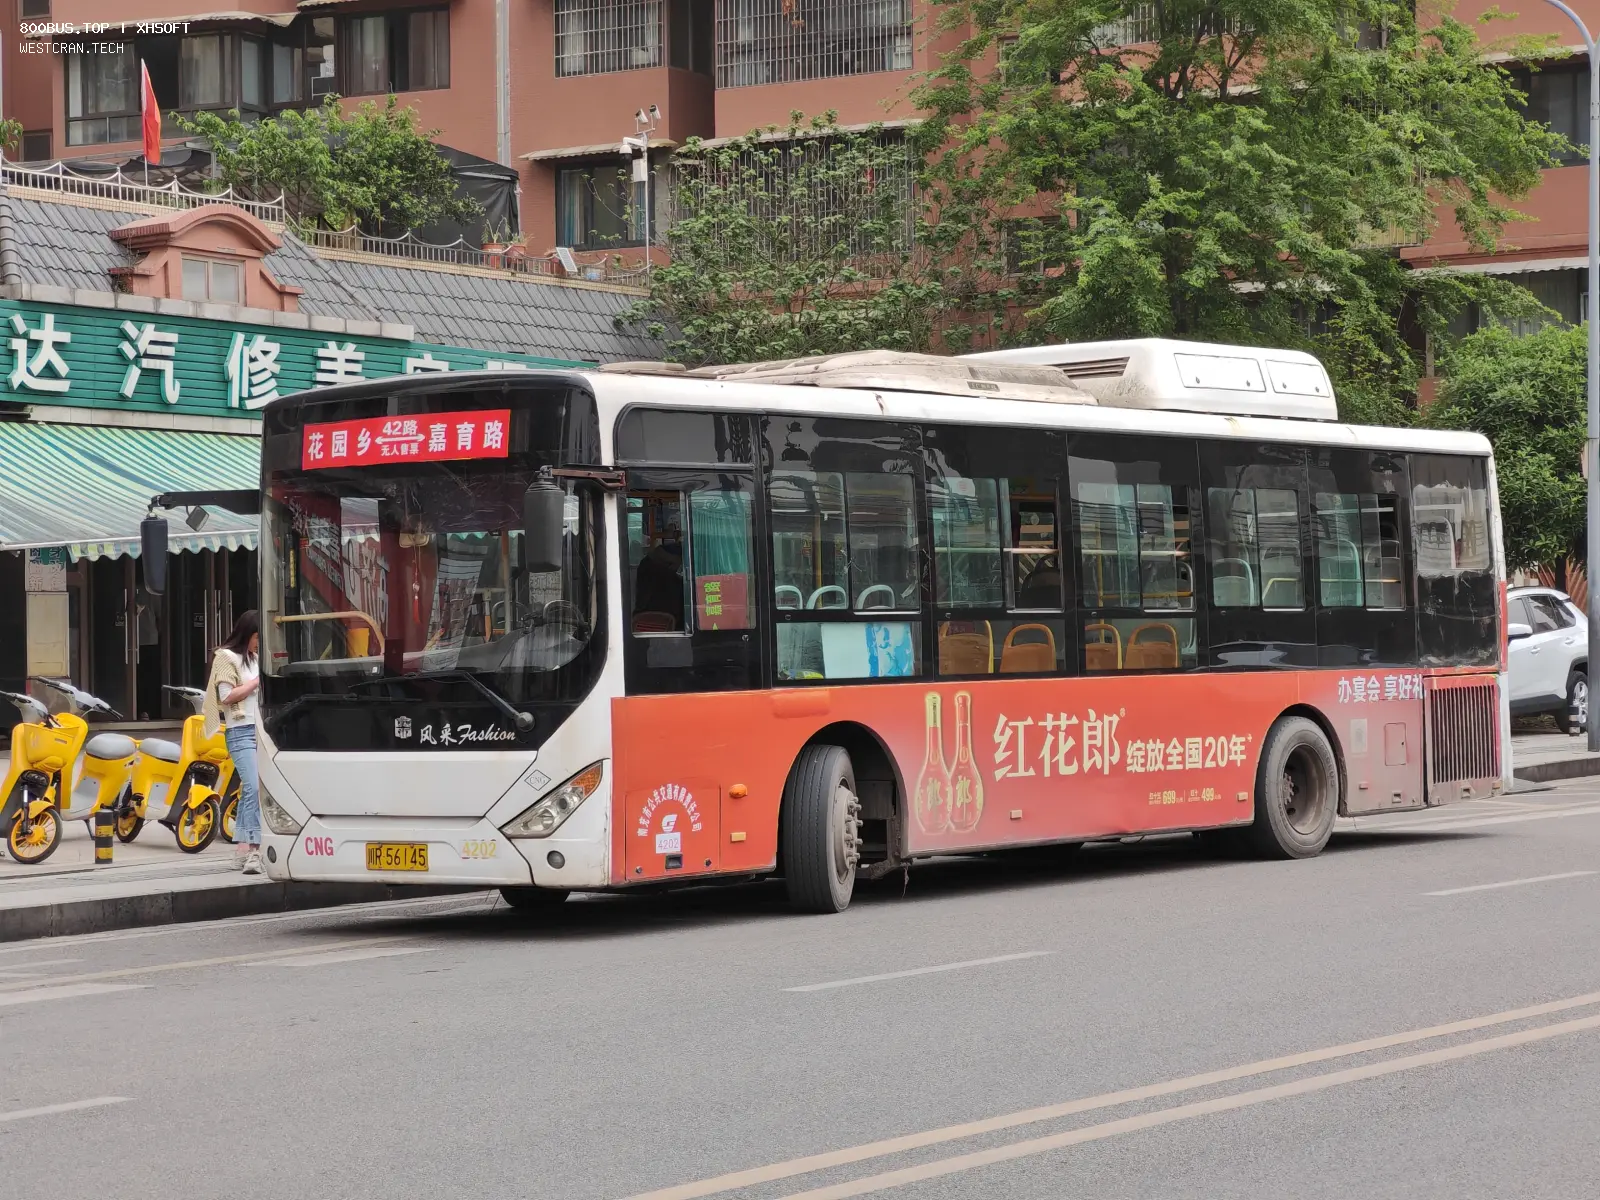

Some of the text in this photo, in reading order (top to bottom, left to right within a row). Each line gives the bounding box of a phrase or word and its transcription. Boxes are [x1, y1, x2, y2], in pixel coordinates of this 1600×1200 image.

[7, 313, 527, 411] 达汽修美
[382, 419, 418, 436] 42路
[308, 420, 504, 461] 花园乡 嘉育路
[1338, 673, 1426, 704] 办宴会 享好礼
[420, 723, 517, 746] 风采 Fashion
[993, 708, 1121, 782] 红花郎
[1162, 790, 1176, 804] 699
[305, 837, 334, 856] CNG
[461, 840, 497, 859] 4202
[658, 839, 679, 851] 4202
